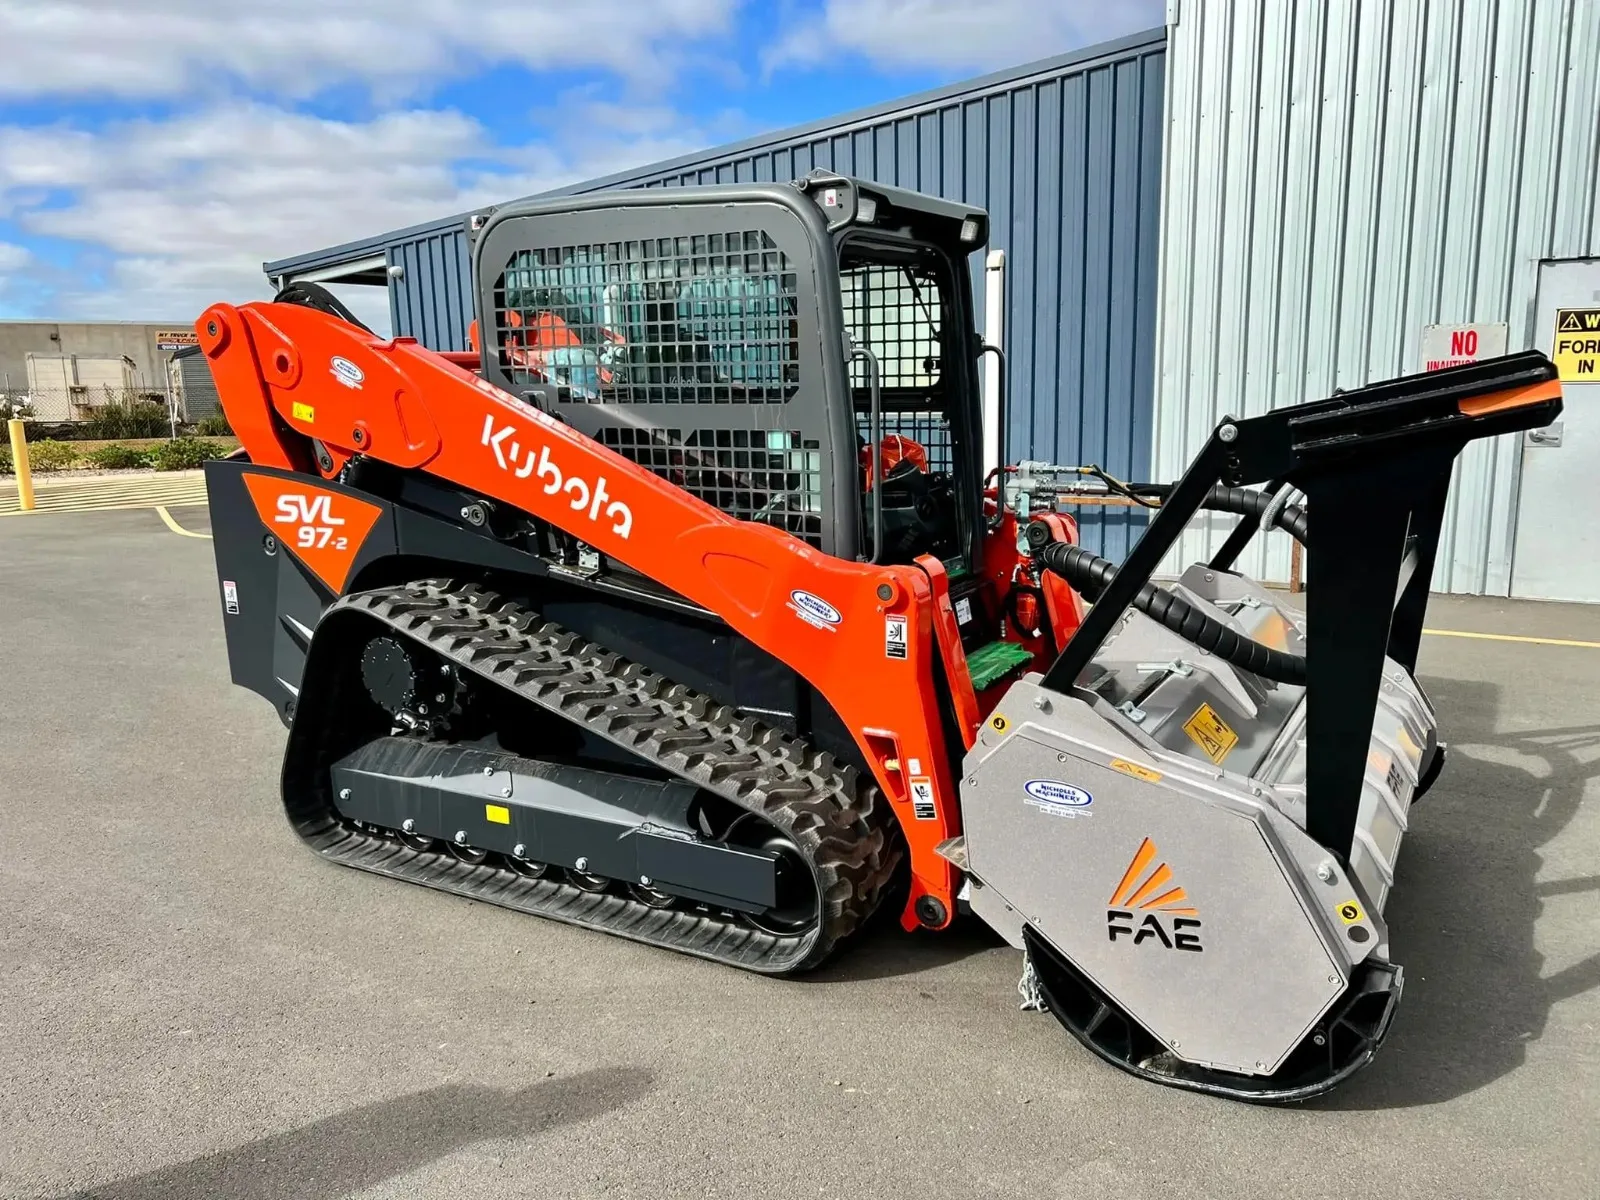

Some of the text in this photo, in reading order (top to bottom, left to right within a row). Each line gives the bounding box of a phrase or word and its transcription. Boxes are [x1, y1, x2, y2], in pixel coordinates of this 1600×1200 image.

[1451, 330, 1478, 356] NO
[1559, 340, 1600, 354] FOR
[1578, 359, 1594, 373] IN
[480, 413, 633, 540] Kubota
[274, 494, 345, 525] SVL
[297, 526, 348, 550] 97-2
[1035, 788, 1081, 803] MACHINERY
[1040, 783, 1077, 796] NICHOLLS
[1107, 910, 1203, 952] FAE
